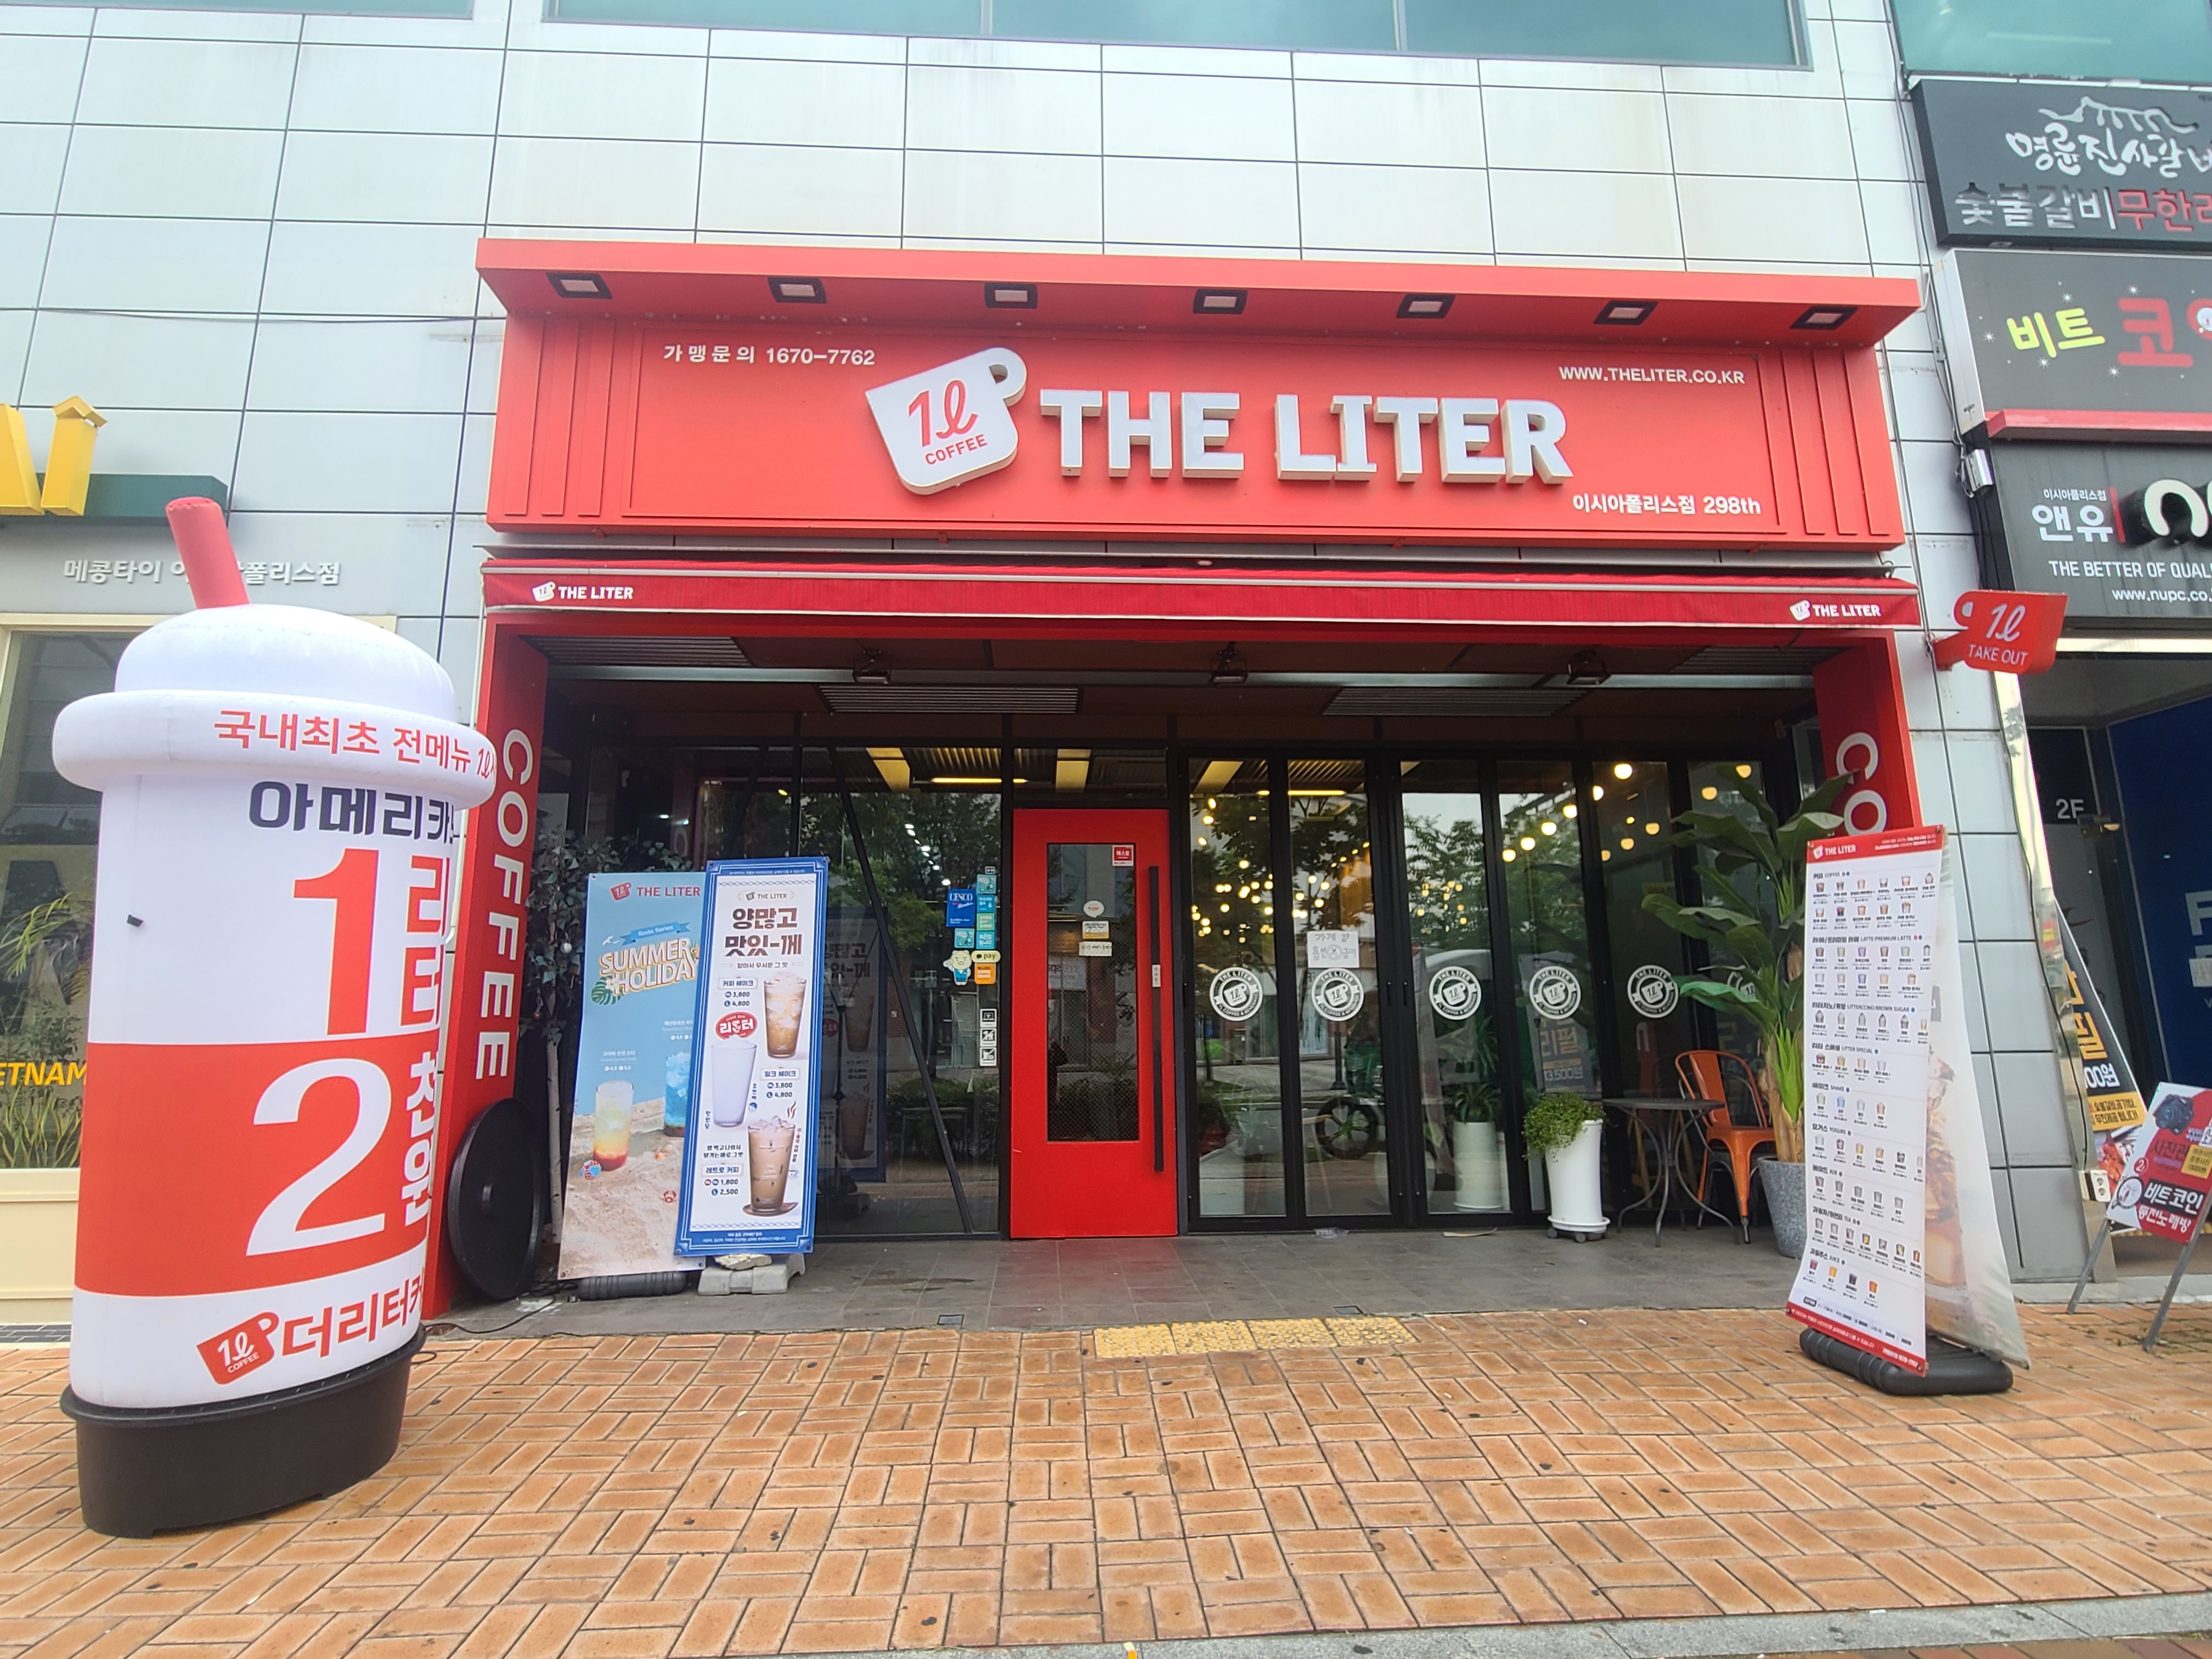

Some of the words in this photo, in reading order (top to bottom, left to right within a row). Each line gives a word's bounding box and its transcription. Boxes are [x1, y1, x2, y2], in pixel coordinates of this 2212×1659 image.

[2006, 307, 2106, 358] 비트
[766, 348, 876, 366] 1670-7762
[1559, 366, 1746, 385] WWW.THELITER.CO.KR
[1040, 390, 1245, 479] THE
[1274, 394, 1574, 486] LITER
[925, 434, 988, 465] COFFEE
[1573, 494, 1695, 516] 이시아폴리스점
[1703, 495, 1762, 516] 298th
[2032, 504, 2114, 543] 앤유
[63, 560, 163, 584] 메콩타이
[2049, 561, 2080, 577] THE
[2084, 562, 2142, 578] BETTER
[2148, 562, 2166, 579] OF
[557, 586, 587, 599] THE
[590, 586, 634, 600] LITER
[1812, 605, 1839, 617] THE
[1841, 605, 1881, 617] LITER
[1968, 644, 1999, 662] TAKE
[2001, 650, 2028, 667] OUT
[214, 710, 380, 755] 국내최초
[393, 727, 472, 774] 전메뉴
[249, 781, 455, 845] 아메리카
[2056, 798, 2085, 820] 2F
[1825, 847, 1837, 856] THE
[1837, 844, 1856, 854] LITER
[636, 887, 661, 896] THE
[665, 887, 701, 896] LITER
[950, 893, 973, 901] CESCO
[475, 729, 533, 1080] COFFEE
[732, 908, 798, 930] 양많고
[293, 848, 380, 1036] 1
[600, 938, 695, 975] SUMMER
[613, 960, 698, 996] HOLIDAY
[1219, 972, 1232, 981] THE
[1233, 971, 1252, 981] LITER
[1321, 973, 1333, 981] THE
[1334, 971, 1353, 982] LITER
[1438, 971, 1450, 980] THE
[1452, 970, 1471, 981] LITER
[246, 1057, 392, 1256] 2
[2144, 1182, 2204, 1215] 비트코인
[2138, 1205, 2192, 1233] 동전노래방
[227, 1352, 260, 1374] COFFEE
